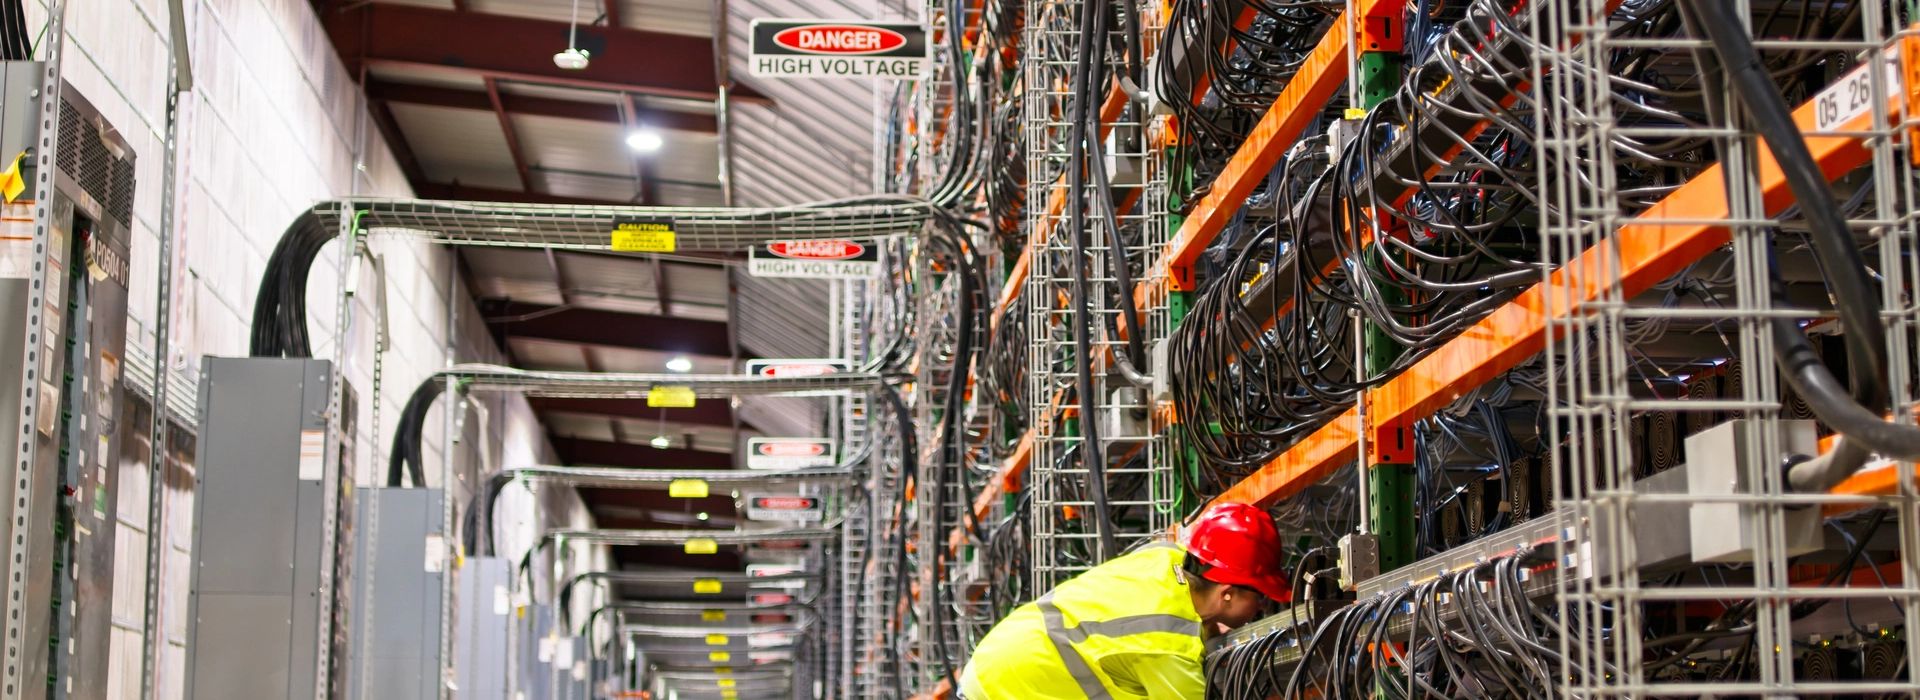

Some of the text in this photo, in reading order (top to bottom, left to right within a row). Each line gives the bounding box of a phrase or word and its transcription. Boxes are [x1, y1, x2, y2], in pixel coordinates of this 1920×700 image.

[799, 30, 882, 49] DANGER
[759, 58, 920, 76] HIGH VOLTAGE
[756, 262, 873, 276] HIGH VOLTAGE
